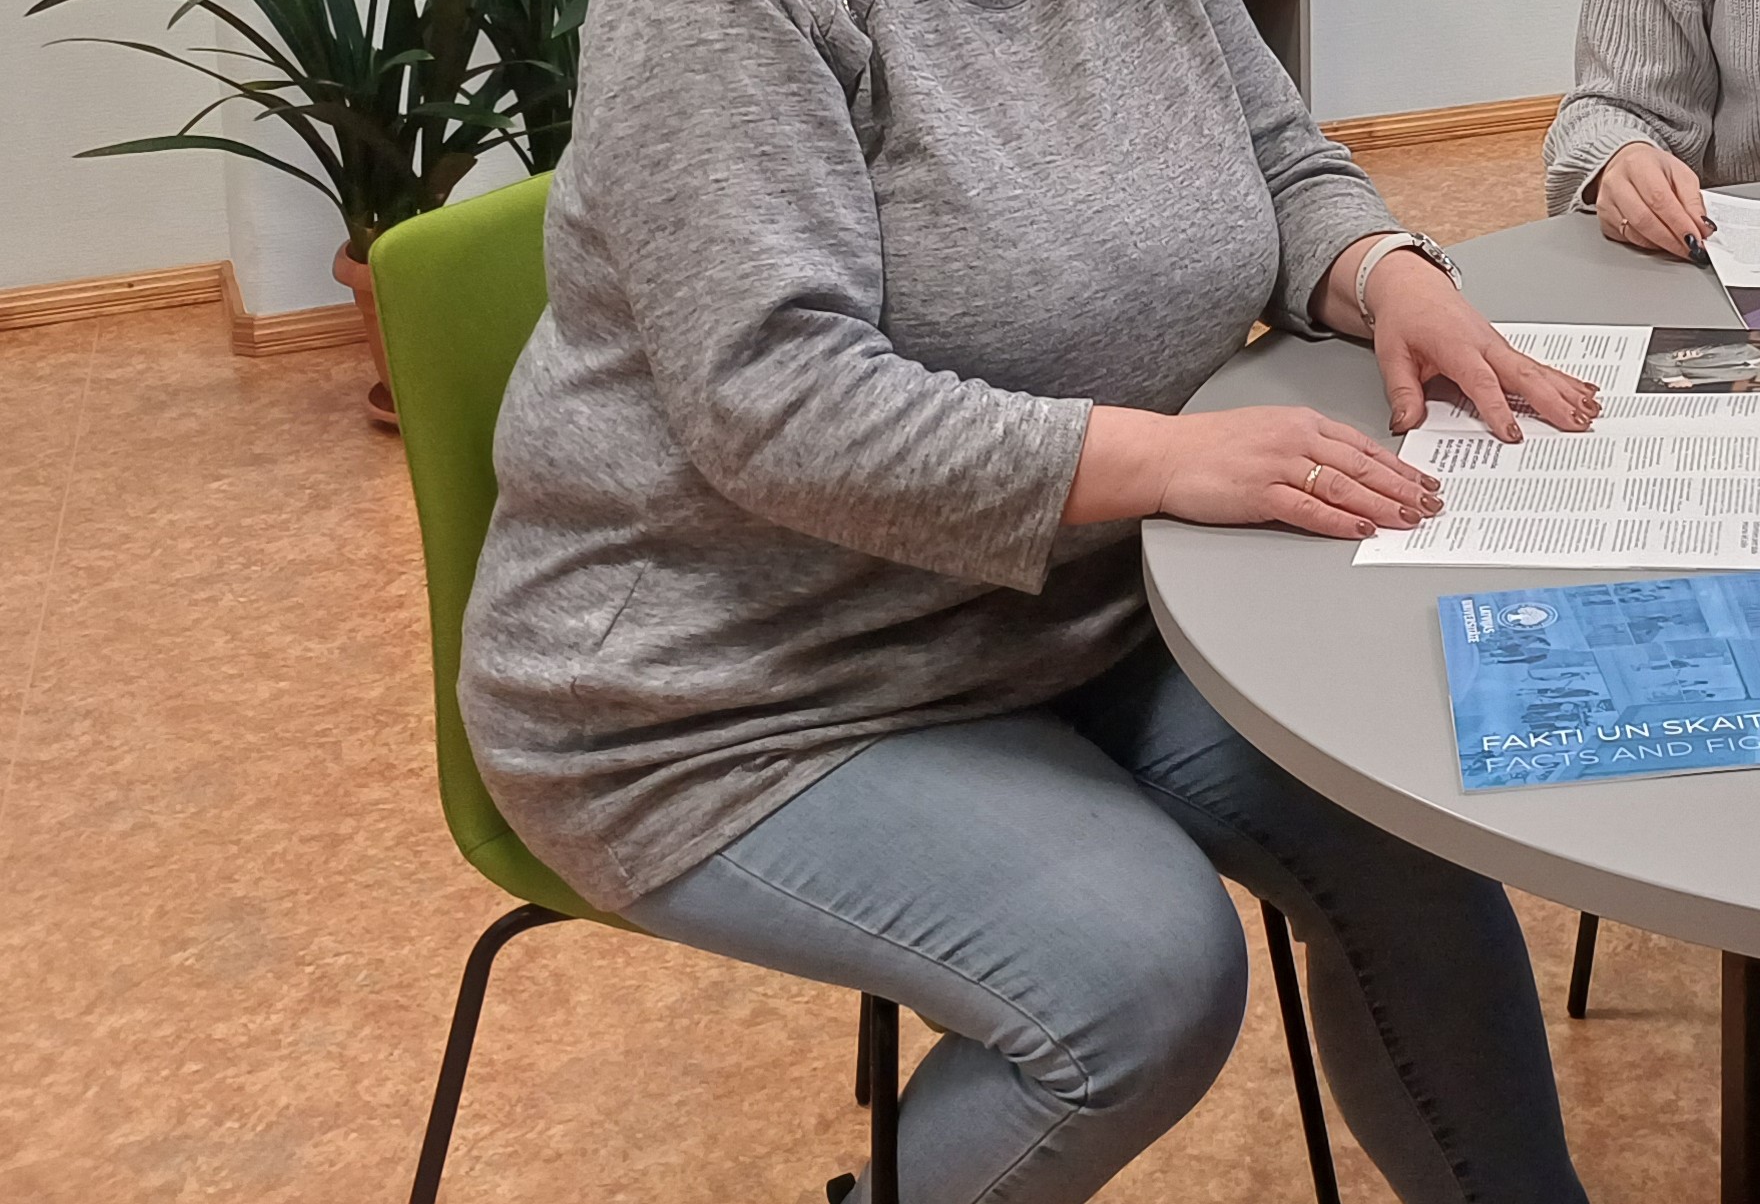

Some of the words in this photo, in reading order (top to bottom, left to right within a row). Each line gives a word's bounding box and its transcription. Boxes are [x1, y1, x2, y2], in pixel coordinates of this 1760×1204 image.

[1481, 726, 1584, 751] FAKTI
[1598, 721, 1649, 742] UN
[1483, 748, 1600, 775] FACTS
[1610, 739, 1695, 765] AND
